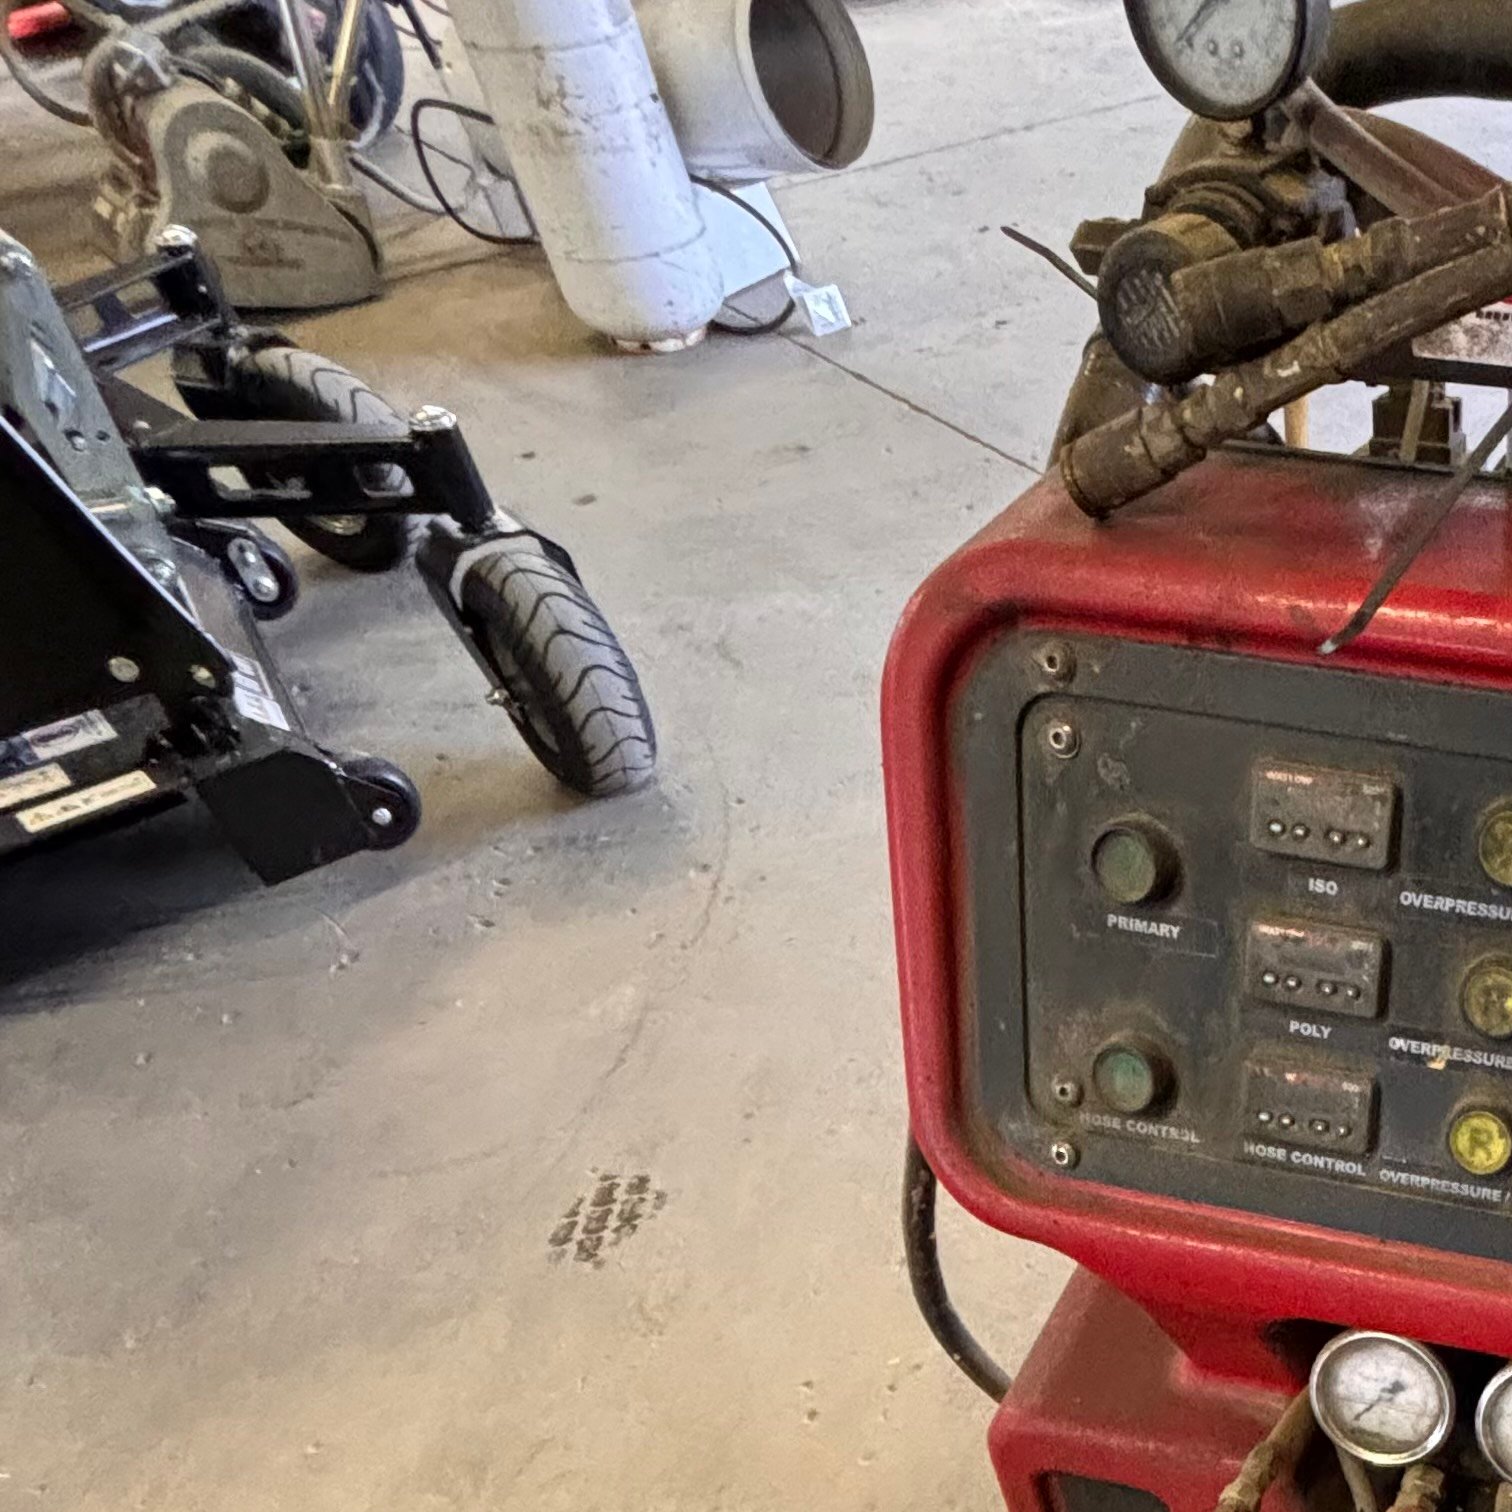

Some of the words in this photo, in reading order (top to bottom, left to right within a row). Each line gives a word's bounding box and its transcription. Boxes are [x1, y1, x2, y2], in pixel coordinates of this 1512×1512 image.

[1308, 877, 1338, 895] ISO
[1107, 913, 1180, 940] PRIMARY
[1289, 1020, 1332, 1039] POLY
[1080, 1112, 1121, 1130] HOSE
[1125, 1119, 1201, 1143] CONTROL
[1243, 1141, 1287, 1162] HOSE
[1290, 1150, 1367, 1177] CONTROL
[1379, 1168, 1502, 1203] OVERPRESSURE
